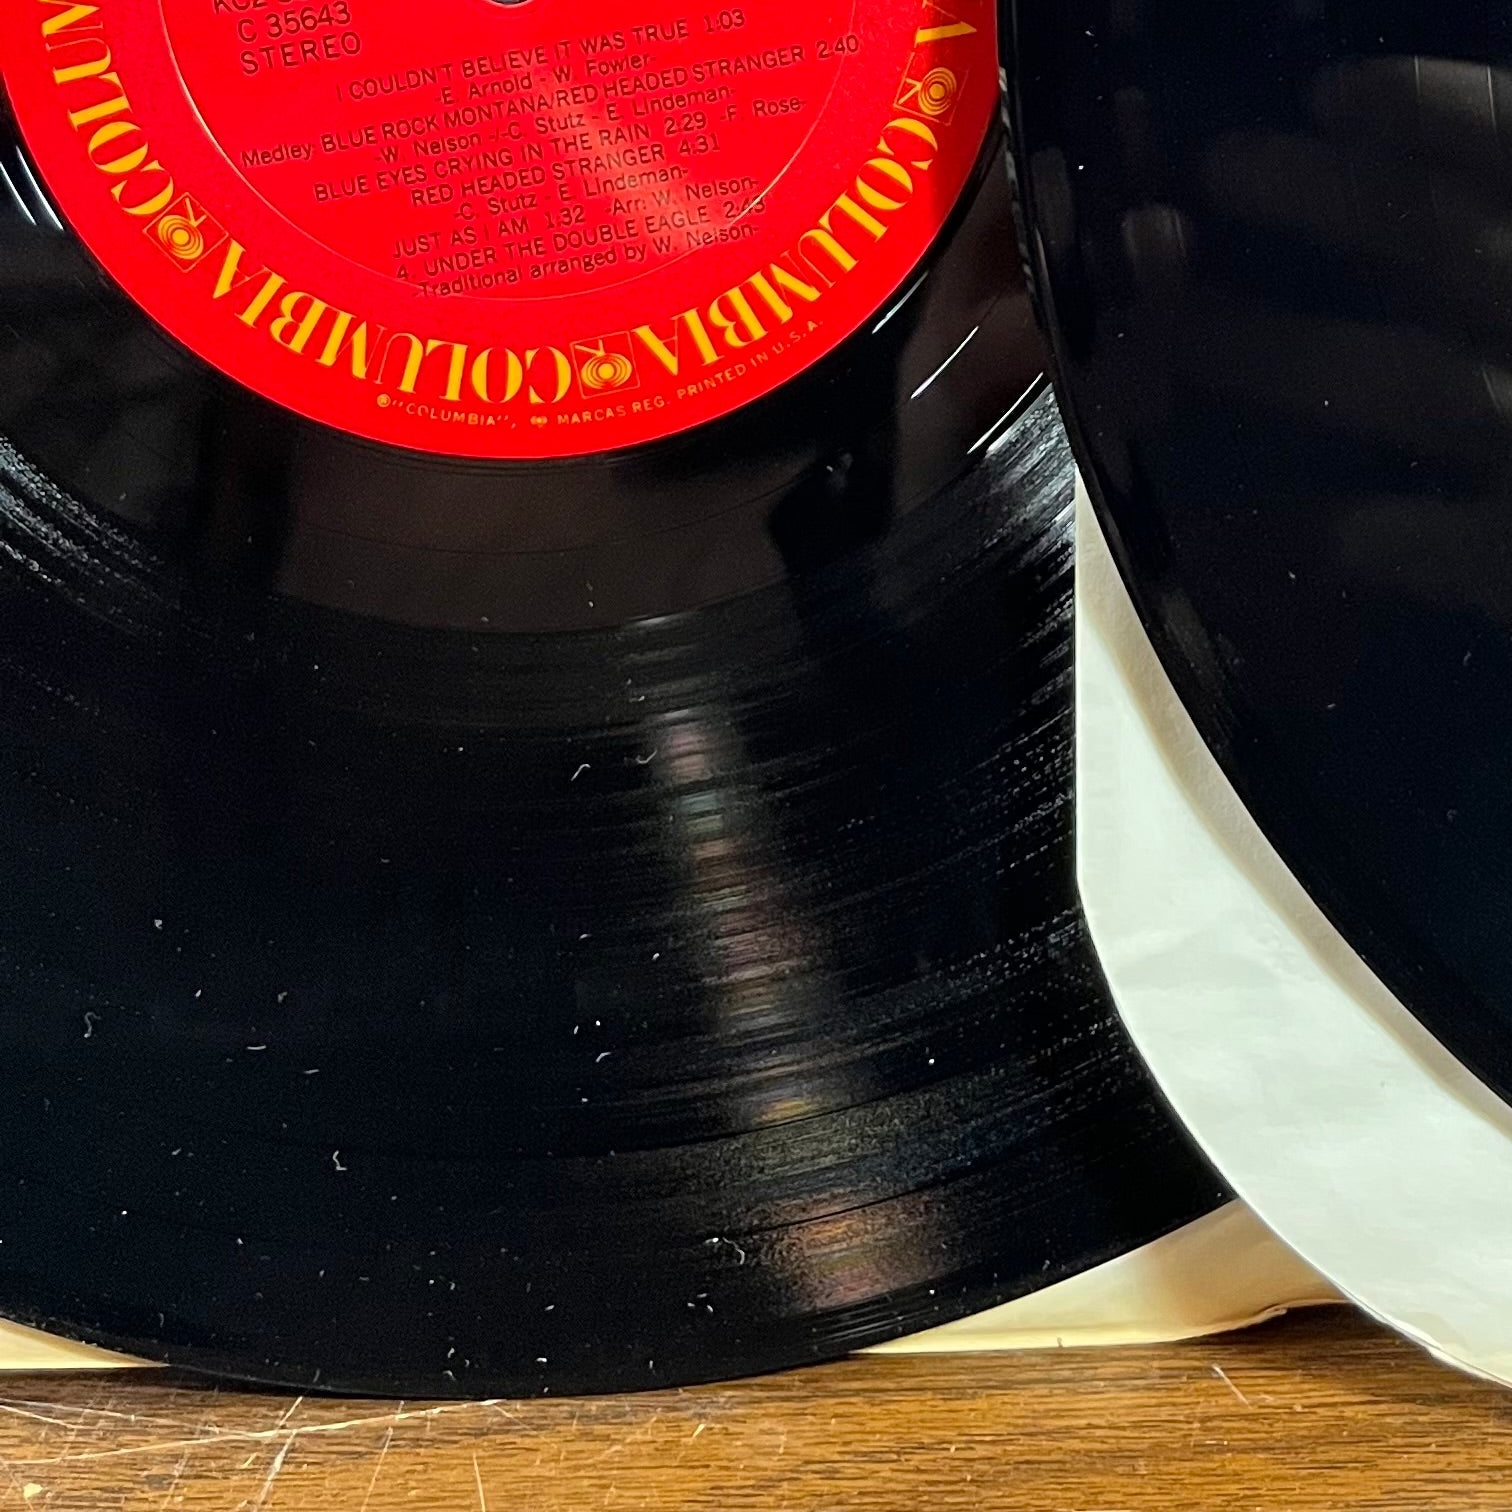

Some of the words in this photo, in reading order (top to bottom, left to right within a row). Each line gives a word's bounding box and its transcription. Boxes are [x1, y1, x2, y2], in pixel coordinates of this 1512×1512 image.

[237, 18, 258, 43] C
[264, 0, 351, 38] 35643
[461, 45, 549, 79] BELIEVE
[554, 40, 571, 60] IT
[578, 30, 626, 55] WAS
[630, 18, 690, 44] TRUE
[240, 31, 361, 75] STEREO
[320, 125, 378, 153] BLUE
[381, 114, 439, 140] ROCK
[603, 67, 688, 99] HEADED
[691, 44, 805, 83] STRANGER
[469, 71, 533, 100] Arnold
[313, 174, 371, 202] BLUE
[376, 164, 428, 191] EYES
[433, 147, 514, 179] CRYING
[520, 142, 543, 162] IN
[549, 132, 593, 154] THE
[598, 123, 650, 147] RAIN
[413, 133, 482, 157] Nelson
[534, 112, 586, 135] Stutz
[411, 183, 454, 208] RED
[460, 165, 546, 198] HEADED
[551, 143, 665, 181] STRANGER
[487, 193, 538, 216] Stutz
[392, 231, 441, 259] JUST
[451, 225, 477, 246] AS
[498, 215, 529, 237] AM
[423, 246, 497, 277] UNDER
[503, 236, 547, 258] THE
[552, 219, 639, 252] DOUBLE
[644, 205, 711, 234] EAGLE
[530, 247, 618, 279] arranged
[623, 243, 646, 263] by
[634, 119, 938, 376] COLUMBIA
[213, 241, 572, 404] COLUMBIA
[557, 404, 627, 425] MARCAS
[676, 362, 747, 400] PRINTED
[750, 351, 769, 368] IN
